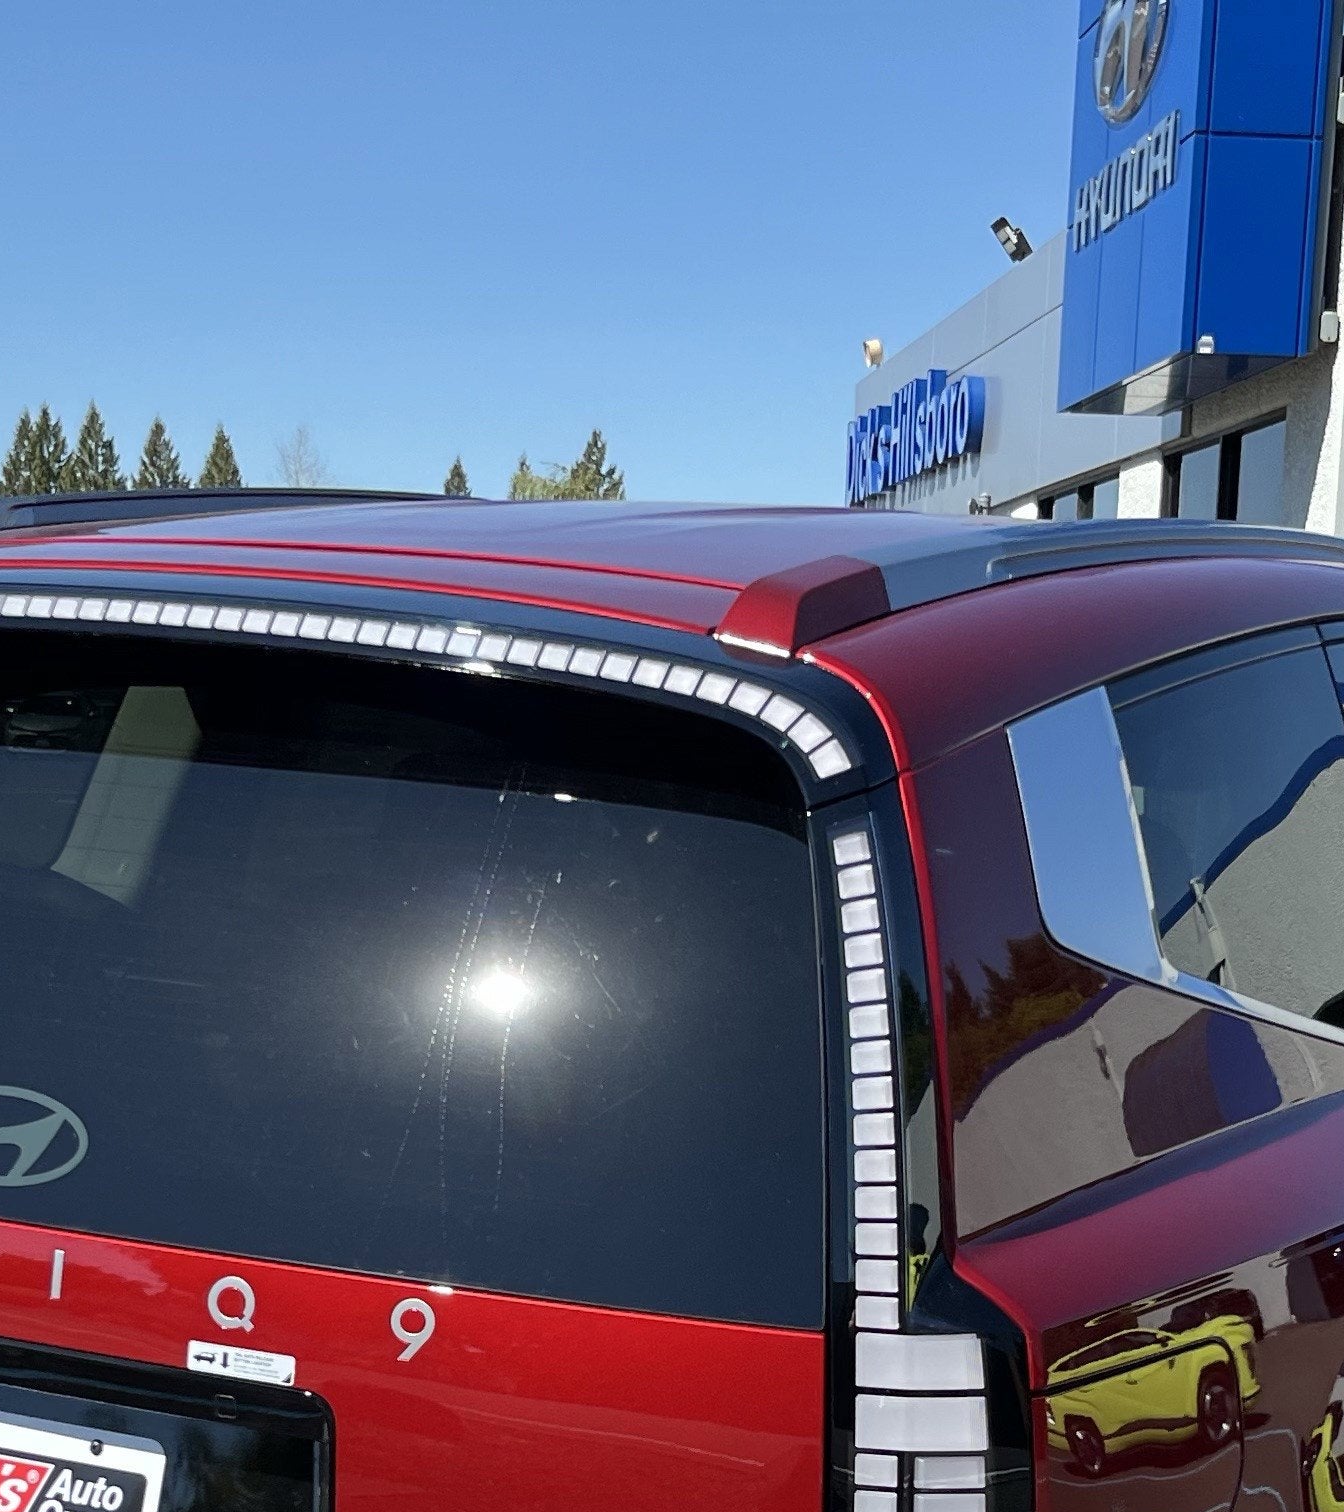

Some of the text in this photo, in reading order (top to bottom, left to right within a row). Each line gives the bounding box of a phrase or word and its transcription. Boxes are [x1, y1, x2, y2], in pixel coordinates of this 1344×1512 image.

[1073, 109, 1180, 253] HYUNDAI
[845, 370, 978, 507] Dick's Hillsboro
[390, 1298, 436, 1362] 9
[45, 1468, 124, 1511] Auto
